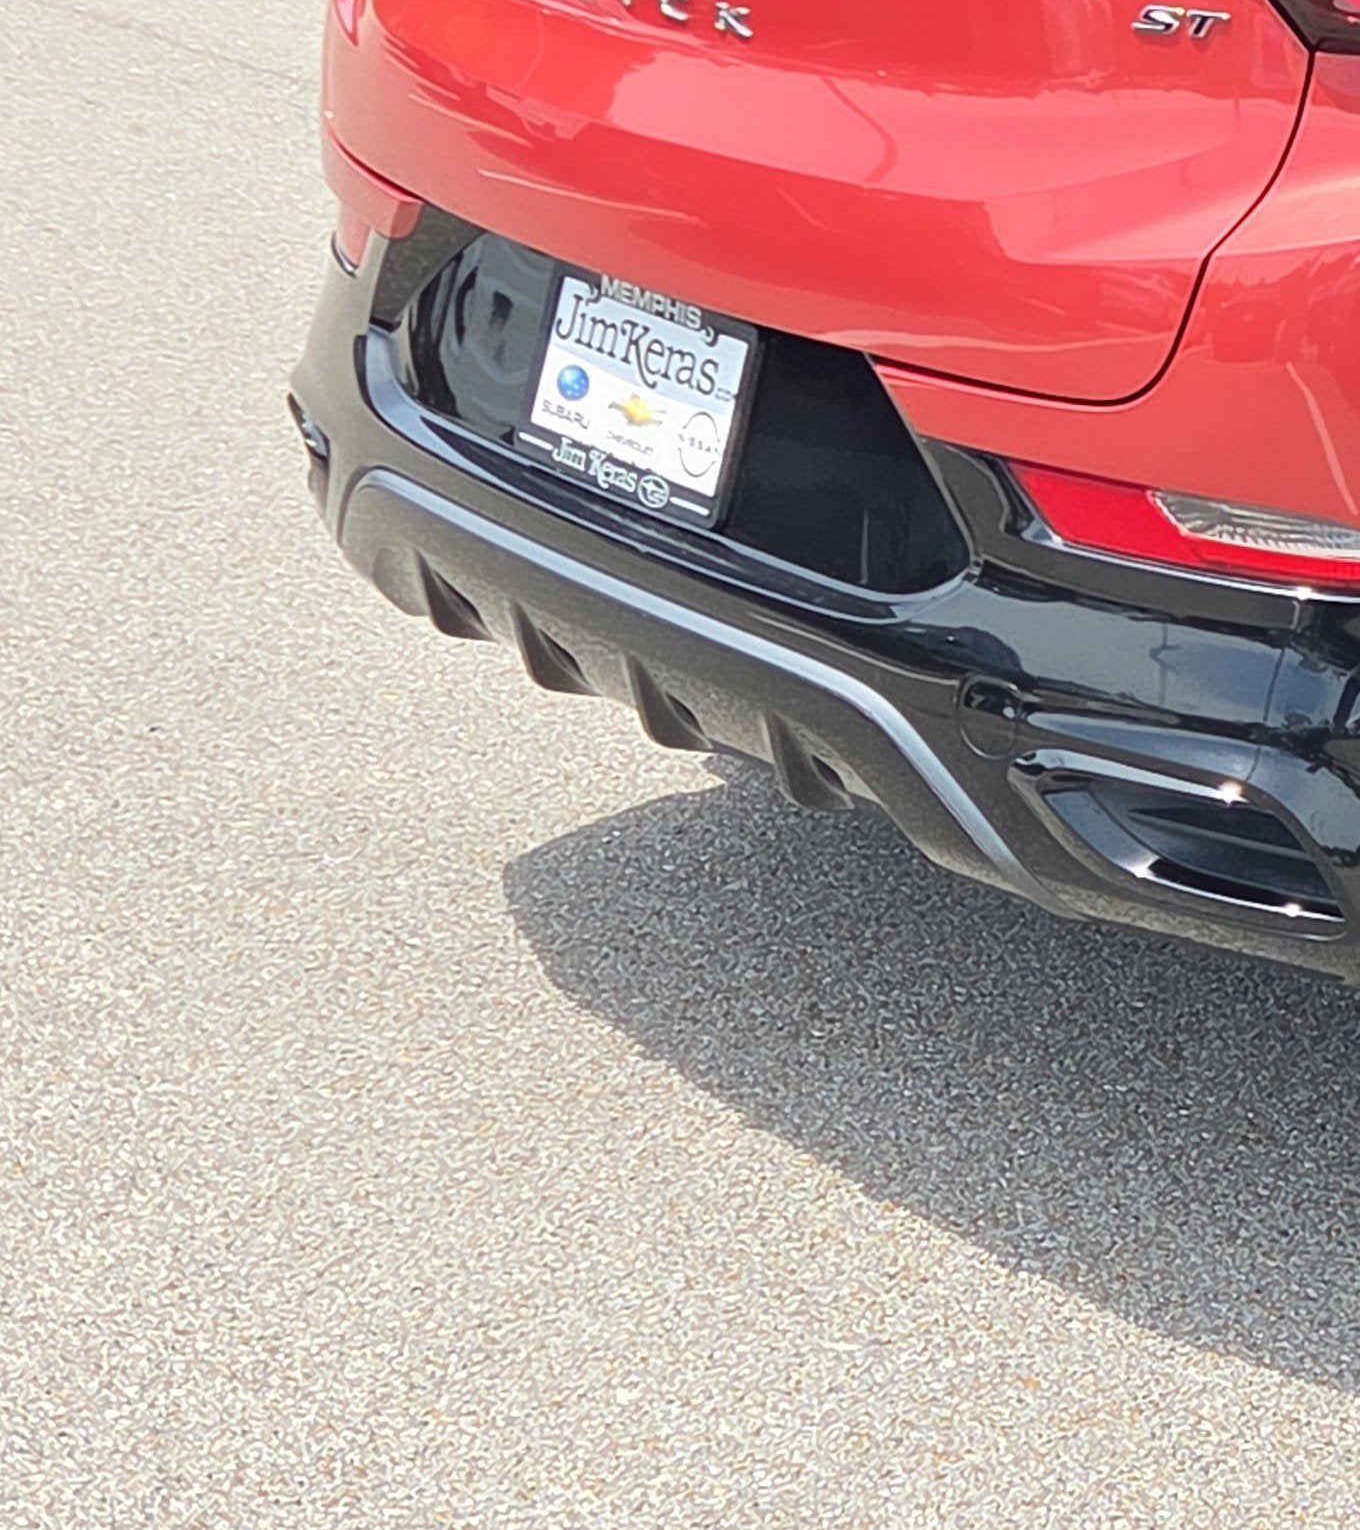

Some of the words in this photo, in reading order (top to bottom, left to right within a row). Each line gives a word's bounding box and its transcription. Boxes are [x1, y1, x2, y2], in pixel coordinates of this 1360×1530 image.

[1130, 4, 1232, 39] ST
[601, 274, 703, 331] MEMPHIS
[552, 437, 587, 472] Jim
[589, 449, 638, 493] Keras
